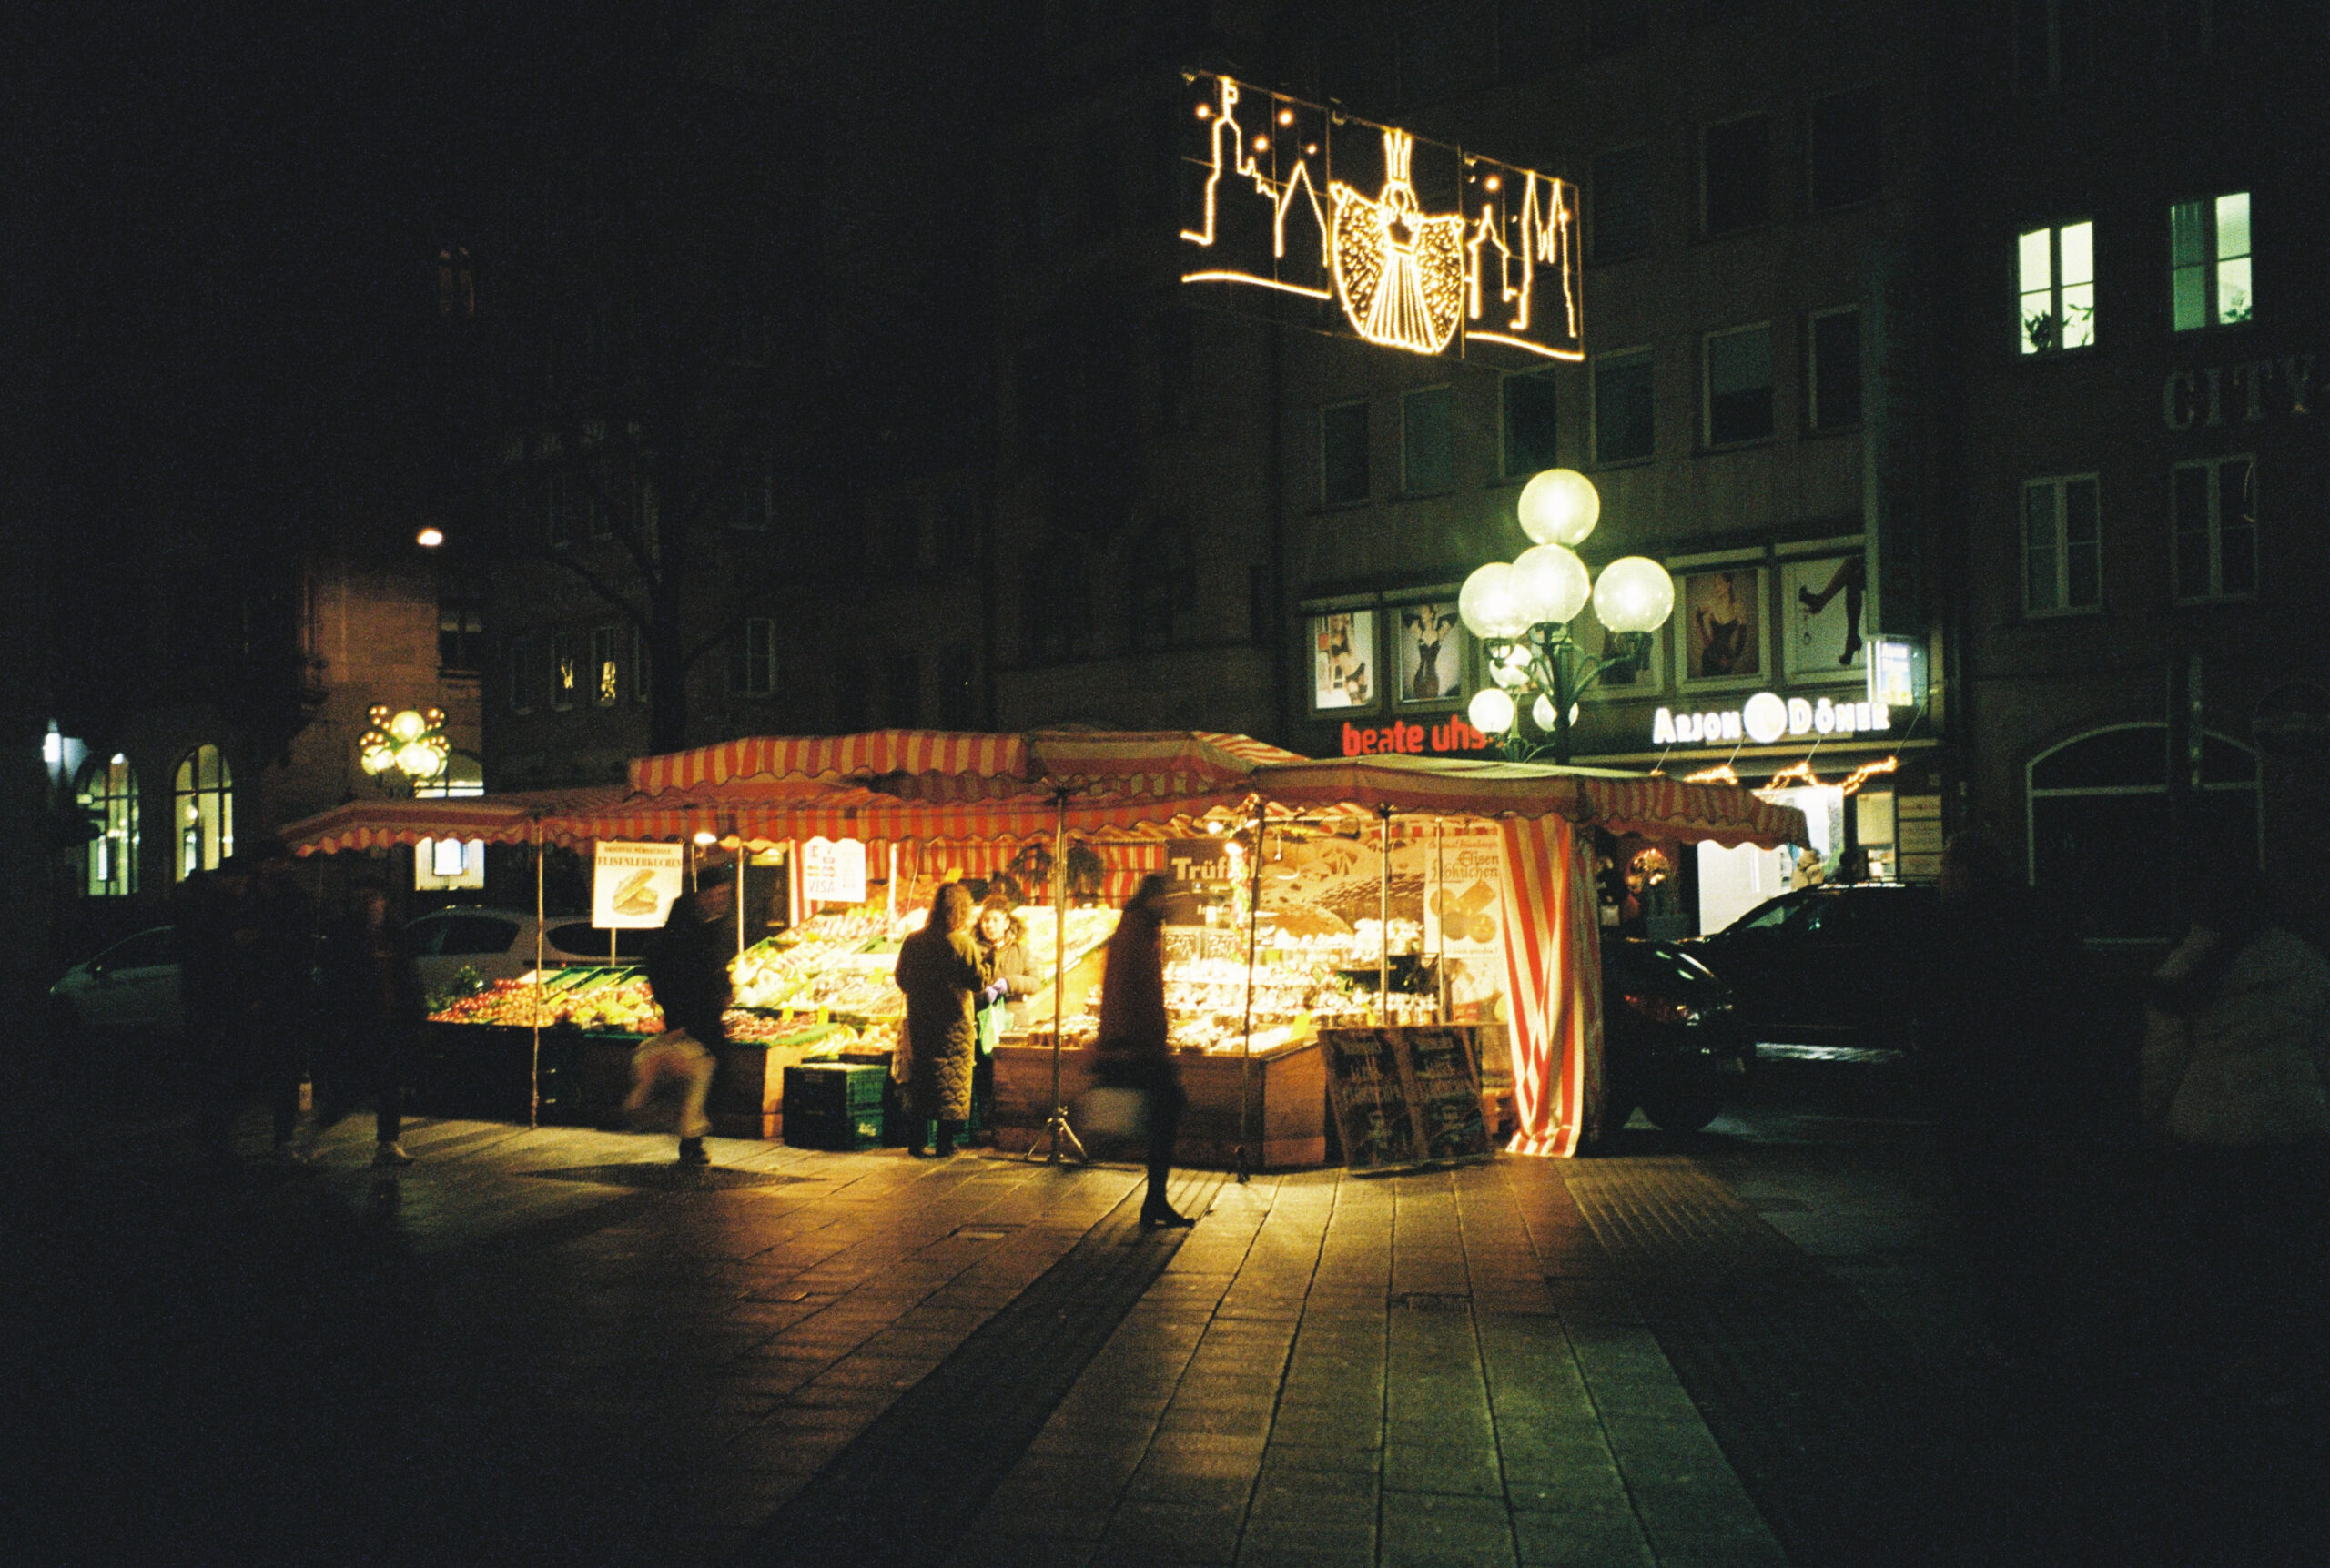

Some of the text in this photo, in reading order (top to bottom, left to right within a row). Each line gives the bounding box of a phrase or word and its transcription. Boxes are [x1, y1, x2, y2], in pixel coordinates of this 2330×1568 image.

[1342, 713, 1504, 757] beate uhs
[1788, 697, 1891, 735] DÖNER
[1170, 856, 1256, 881] Trüfl
